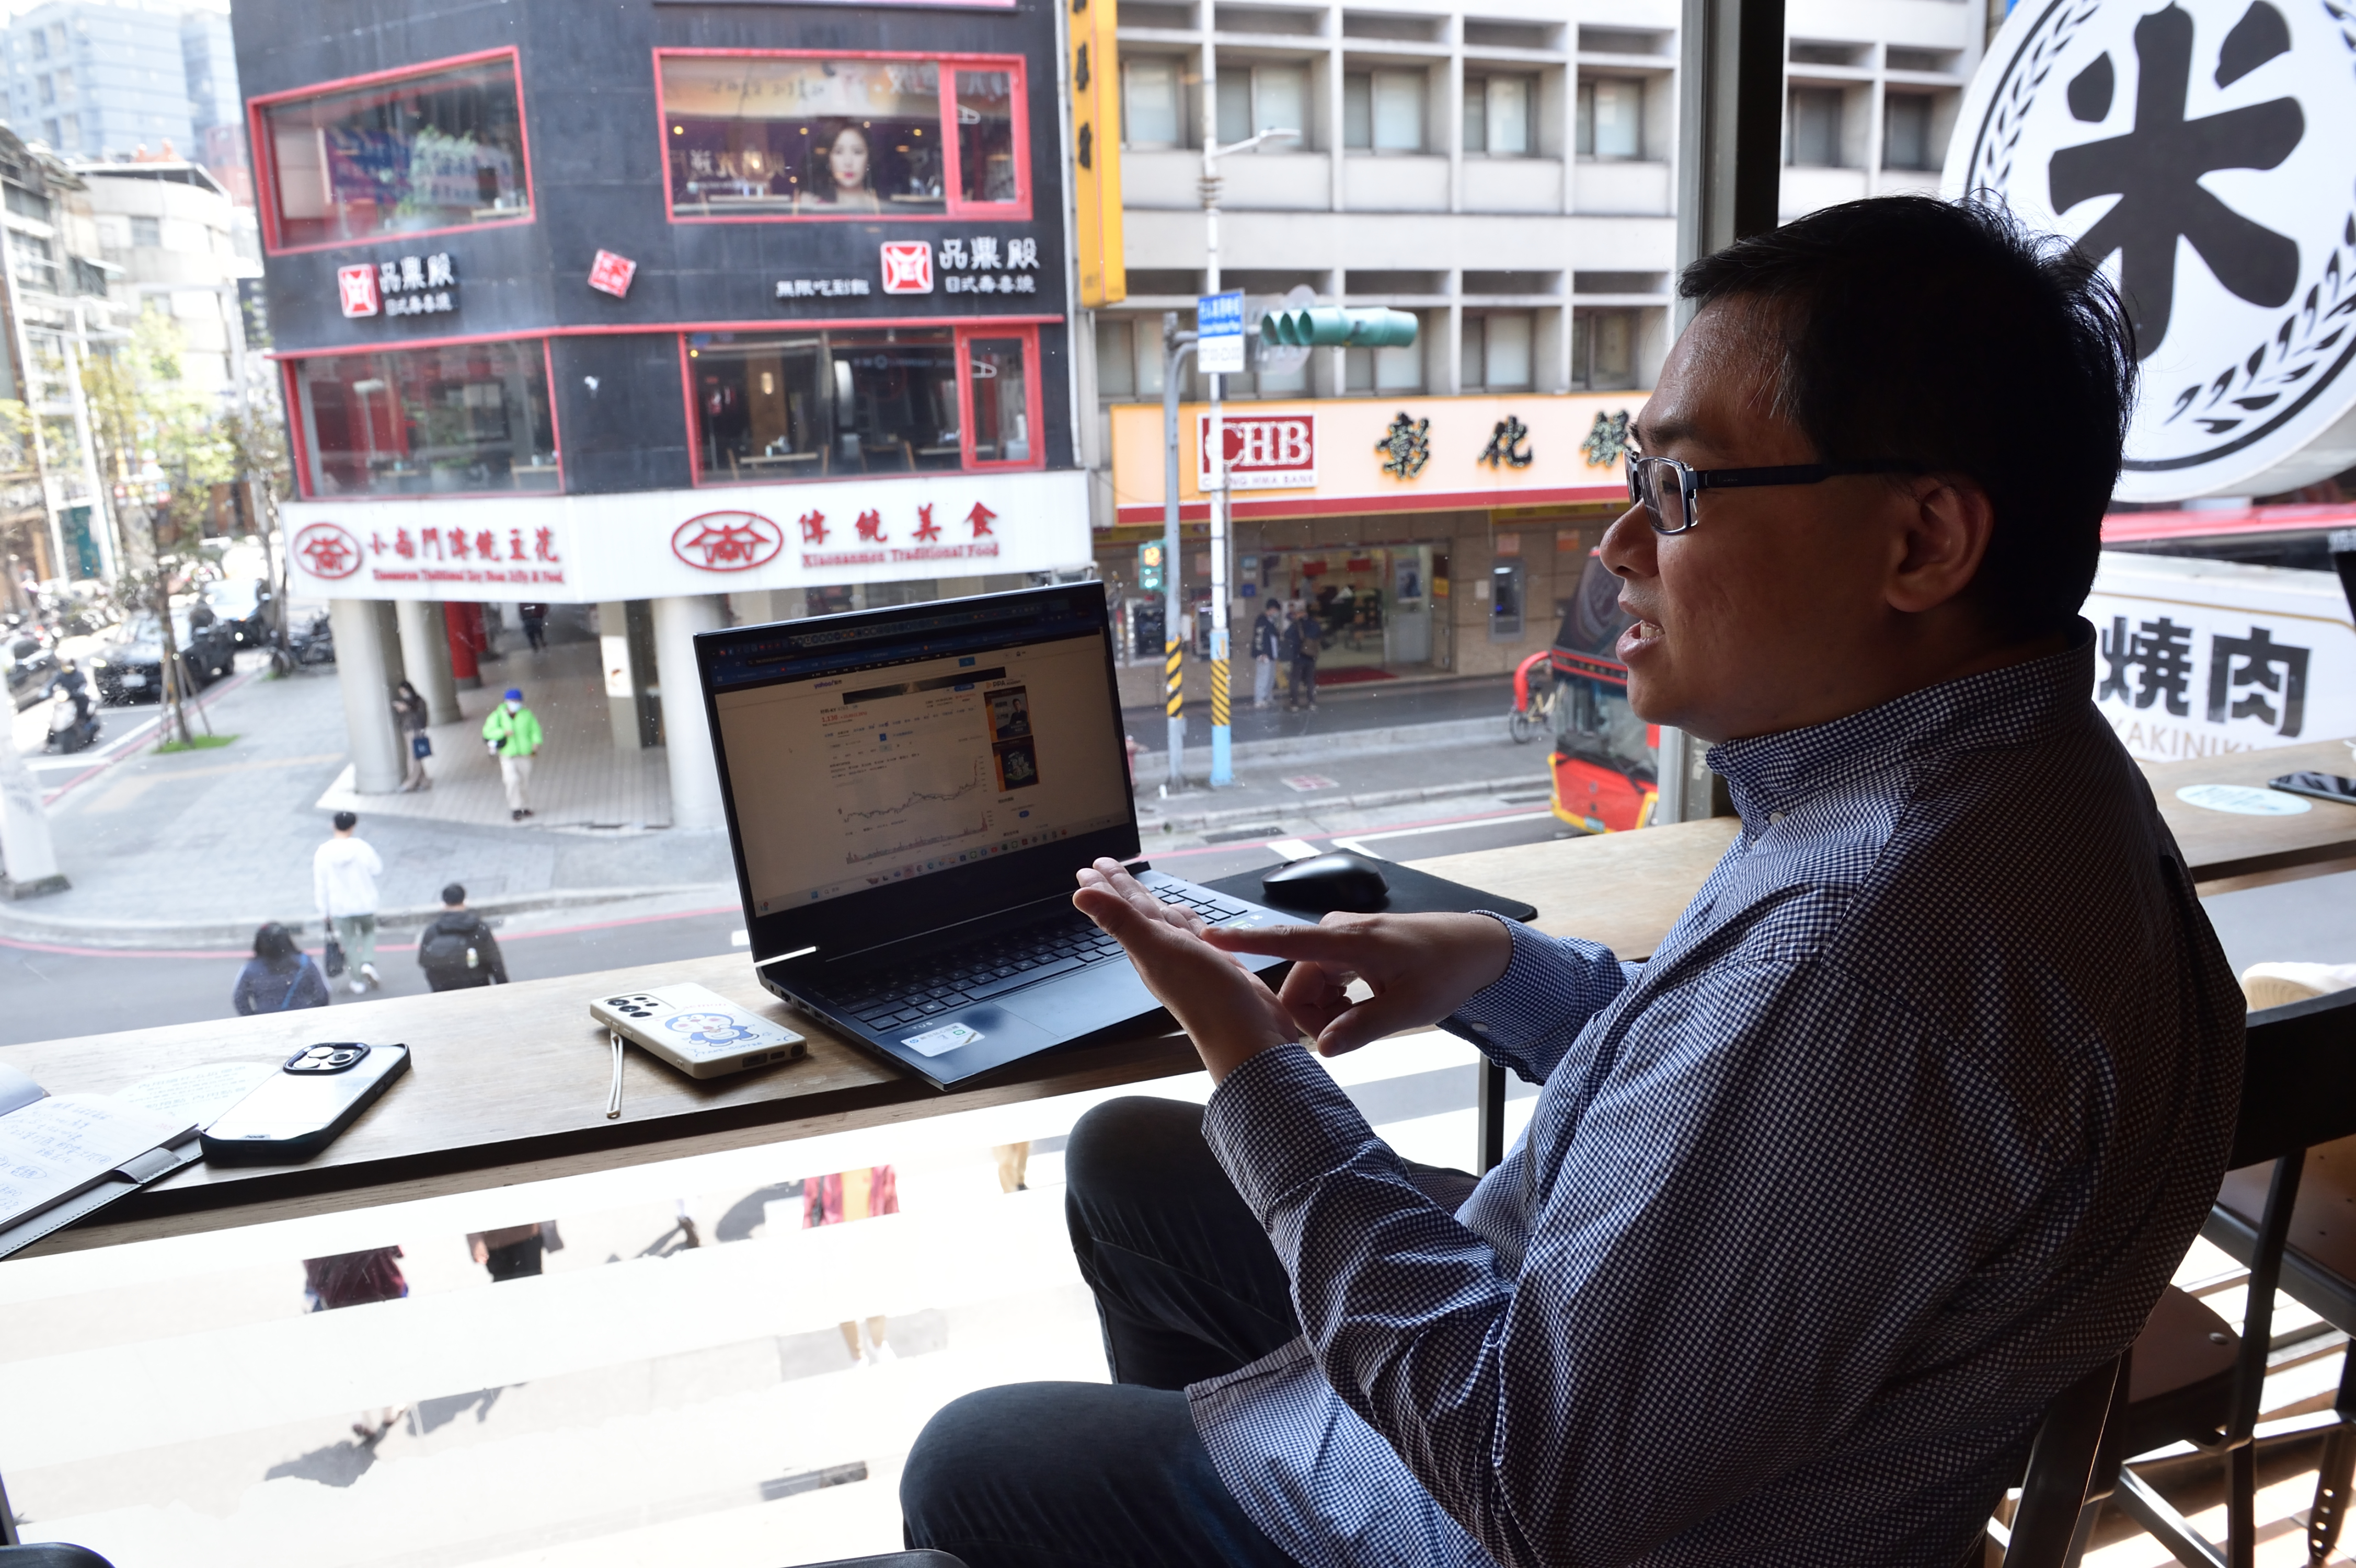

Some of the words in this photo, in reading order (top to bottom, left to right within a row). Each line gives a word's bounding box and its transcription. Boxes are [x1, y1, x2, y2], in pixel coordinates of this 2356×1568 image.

[2049, 1, 2305, 362] 米
[1204, 420, 1312, 467] CHB
[1203, 475, 1248, 486] CNG
[799, 501, 997, 545] 傳統美食
[891, 546, 963, 562] Traditional
[968, 542, 999, 558] Food
[2098, 615, 2313, 739] 燒肉
